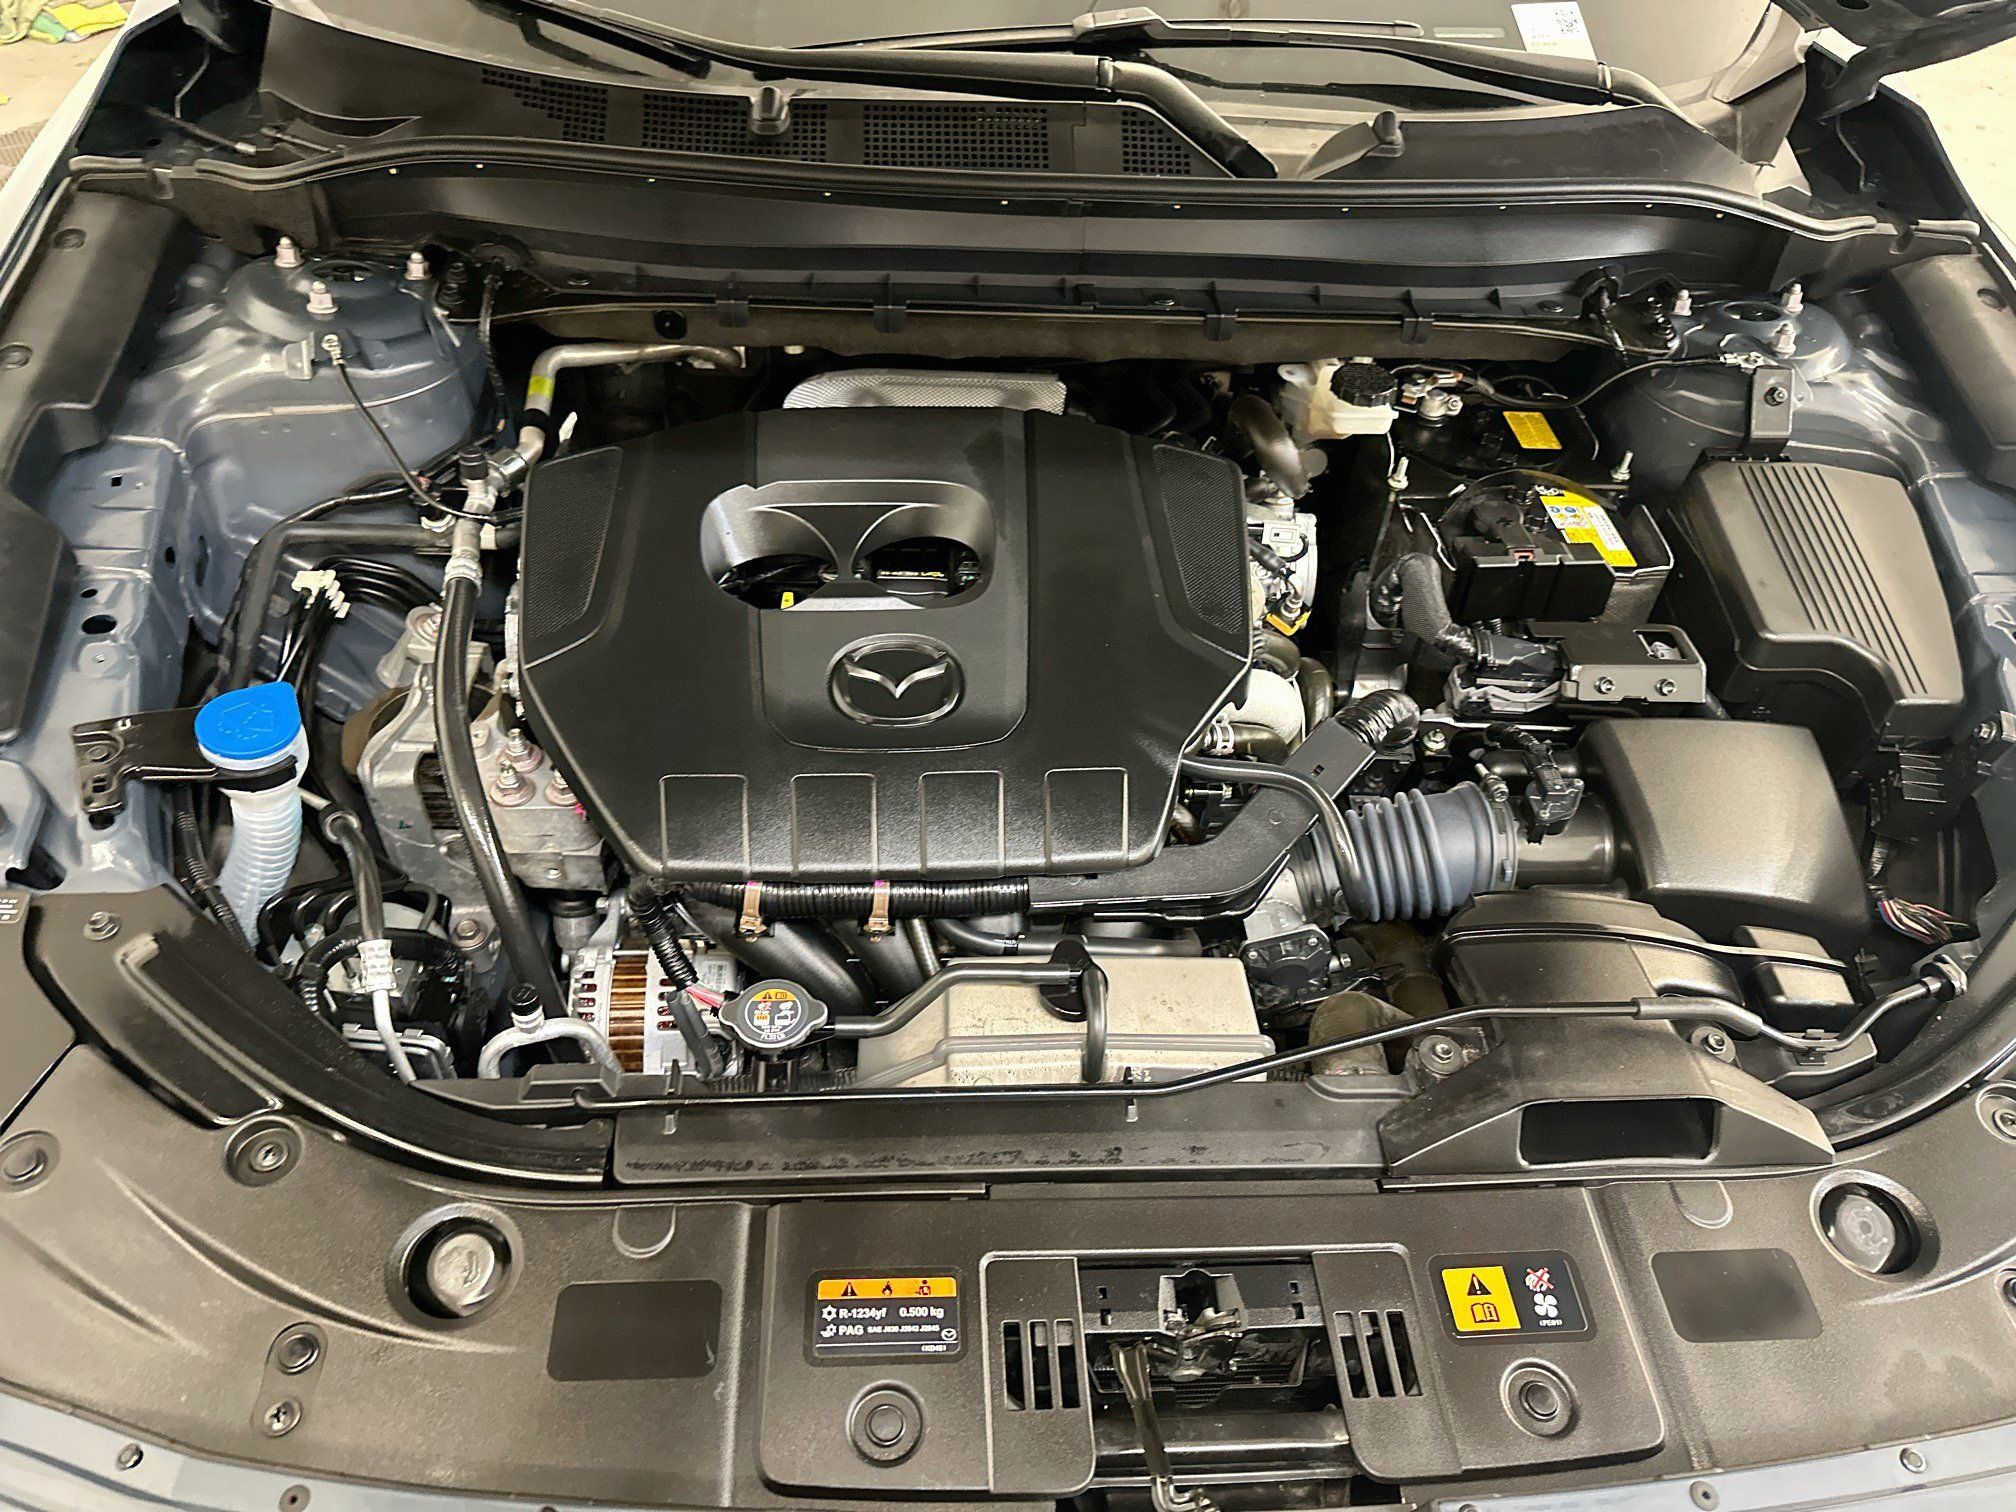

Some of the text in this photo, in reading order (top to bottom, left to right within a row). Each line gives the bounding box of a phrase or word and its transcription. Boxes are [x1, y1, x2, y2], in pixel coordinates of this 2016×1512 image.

[839, 1306, 944, 1320] R-1234yf 0.500 kg
[838, 1325, 864, 1336] PAG
